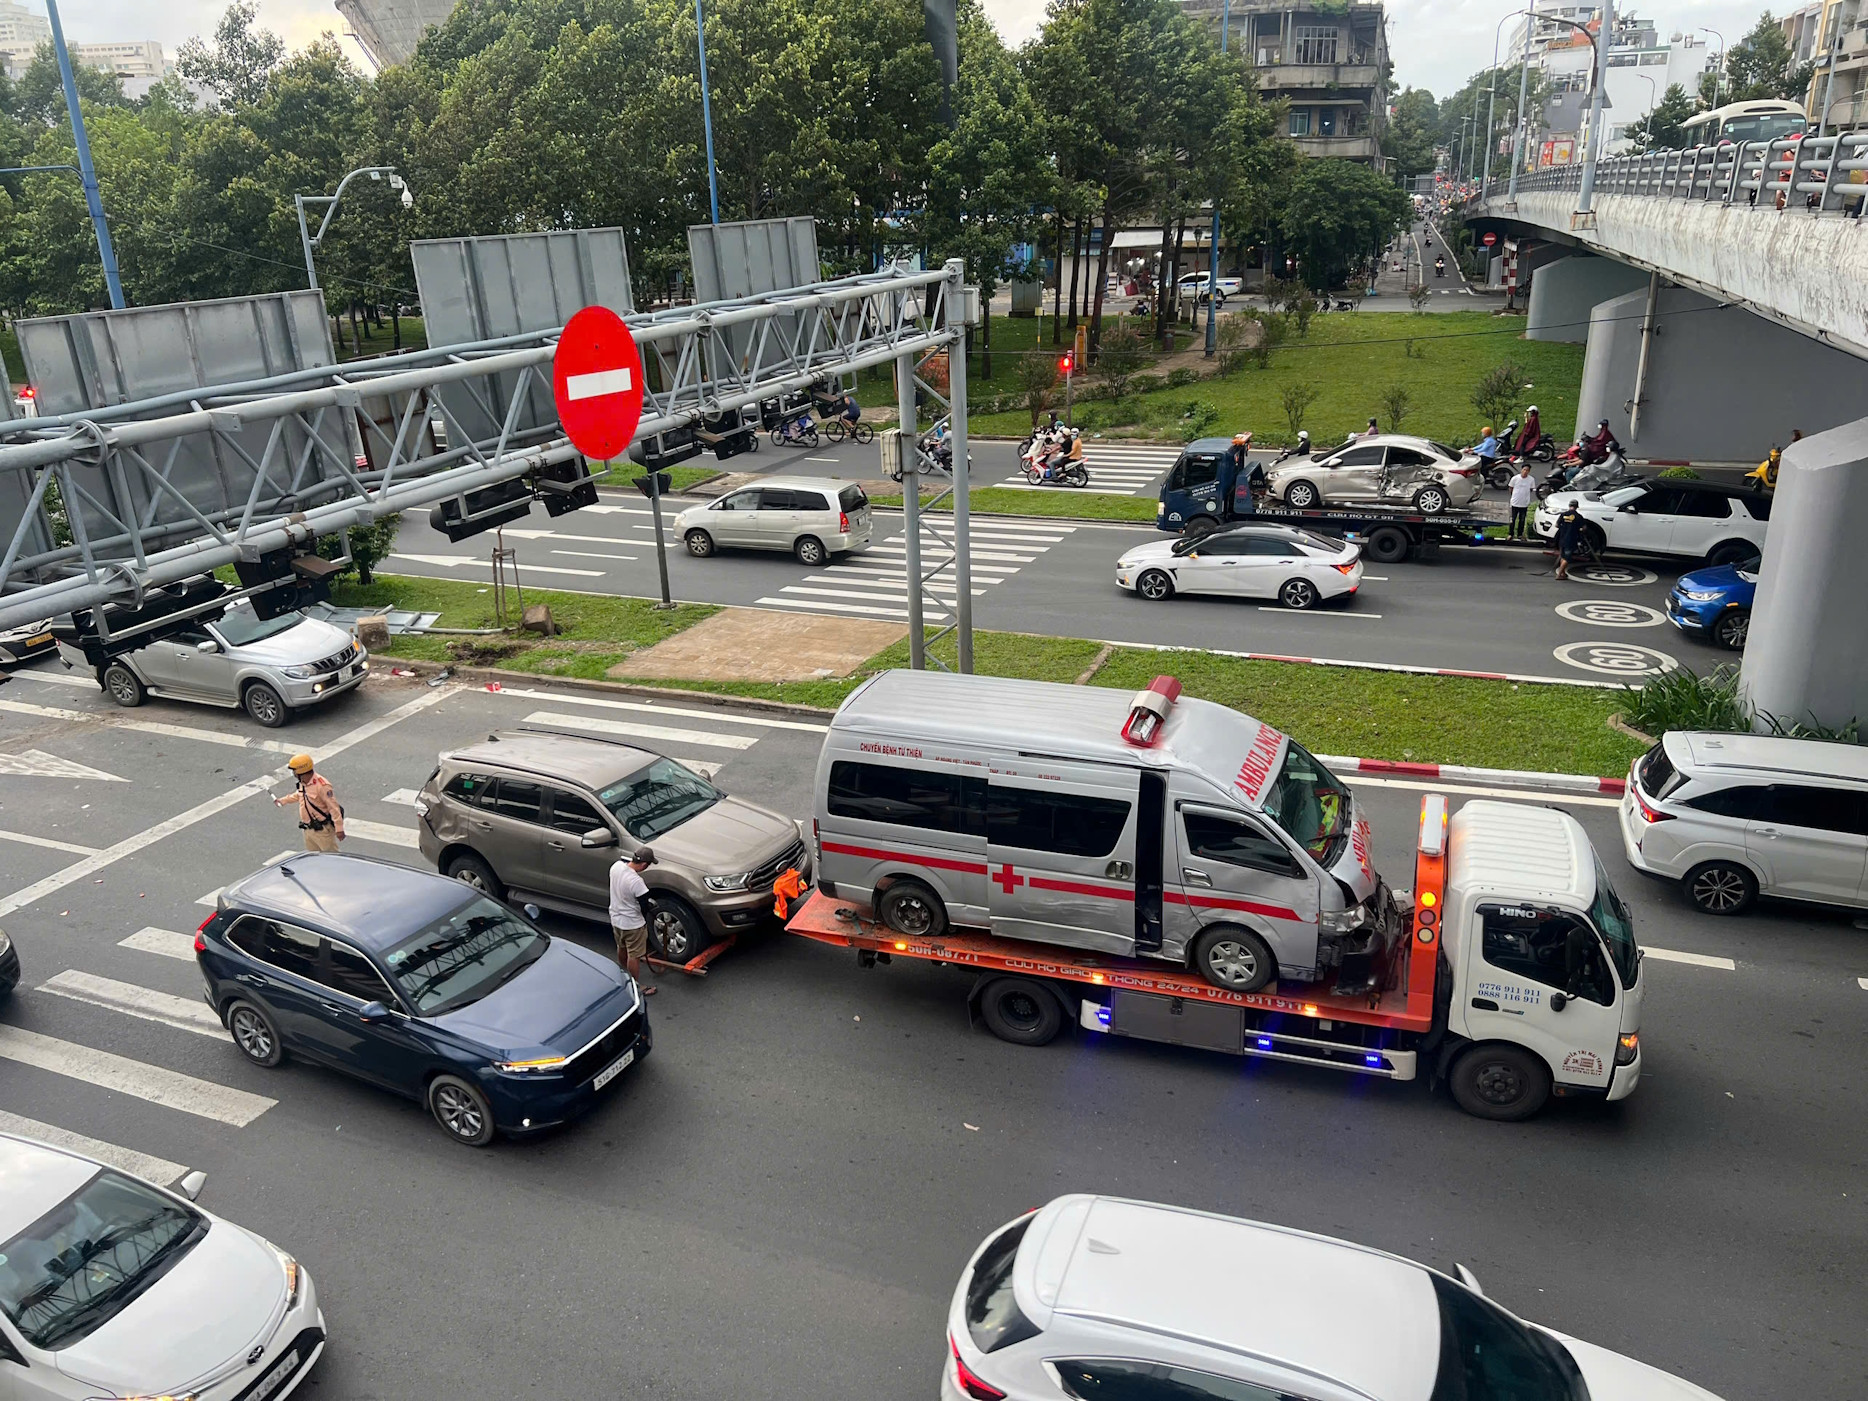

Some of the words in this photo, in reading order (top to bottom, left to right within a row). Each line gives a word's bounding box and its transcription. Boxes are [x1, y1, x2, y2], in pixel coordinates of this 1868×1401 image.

[1585, 605, 1637, 622] 60
[1589, 649, 1648, 669] 60
[1233, 724, 1283, 802] AMBULANCE
[1499, 907, 1537, 919] HINO
[1157, 982, 1199, 994] 24/24
[1207, 989, 1242, 1001] 0776
[1246, 995, 1273, 1006] 911
[1276, 1000, 1303, 1011] 911
[1478, 990, 1500, 998] 0888
[1504, 993, 1520, 1001] 116
[1523, 996, 1540, 1004] 911
[1479, 983, 1501, 991] 0776
[1504, 985, 1520, 993] 911
[1524, 988, 1541, 997] 911
